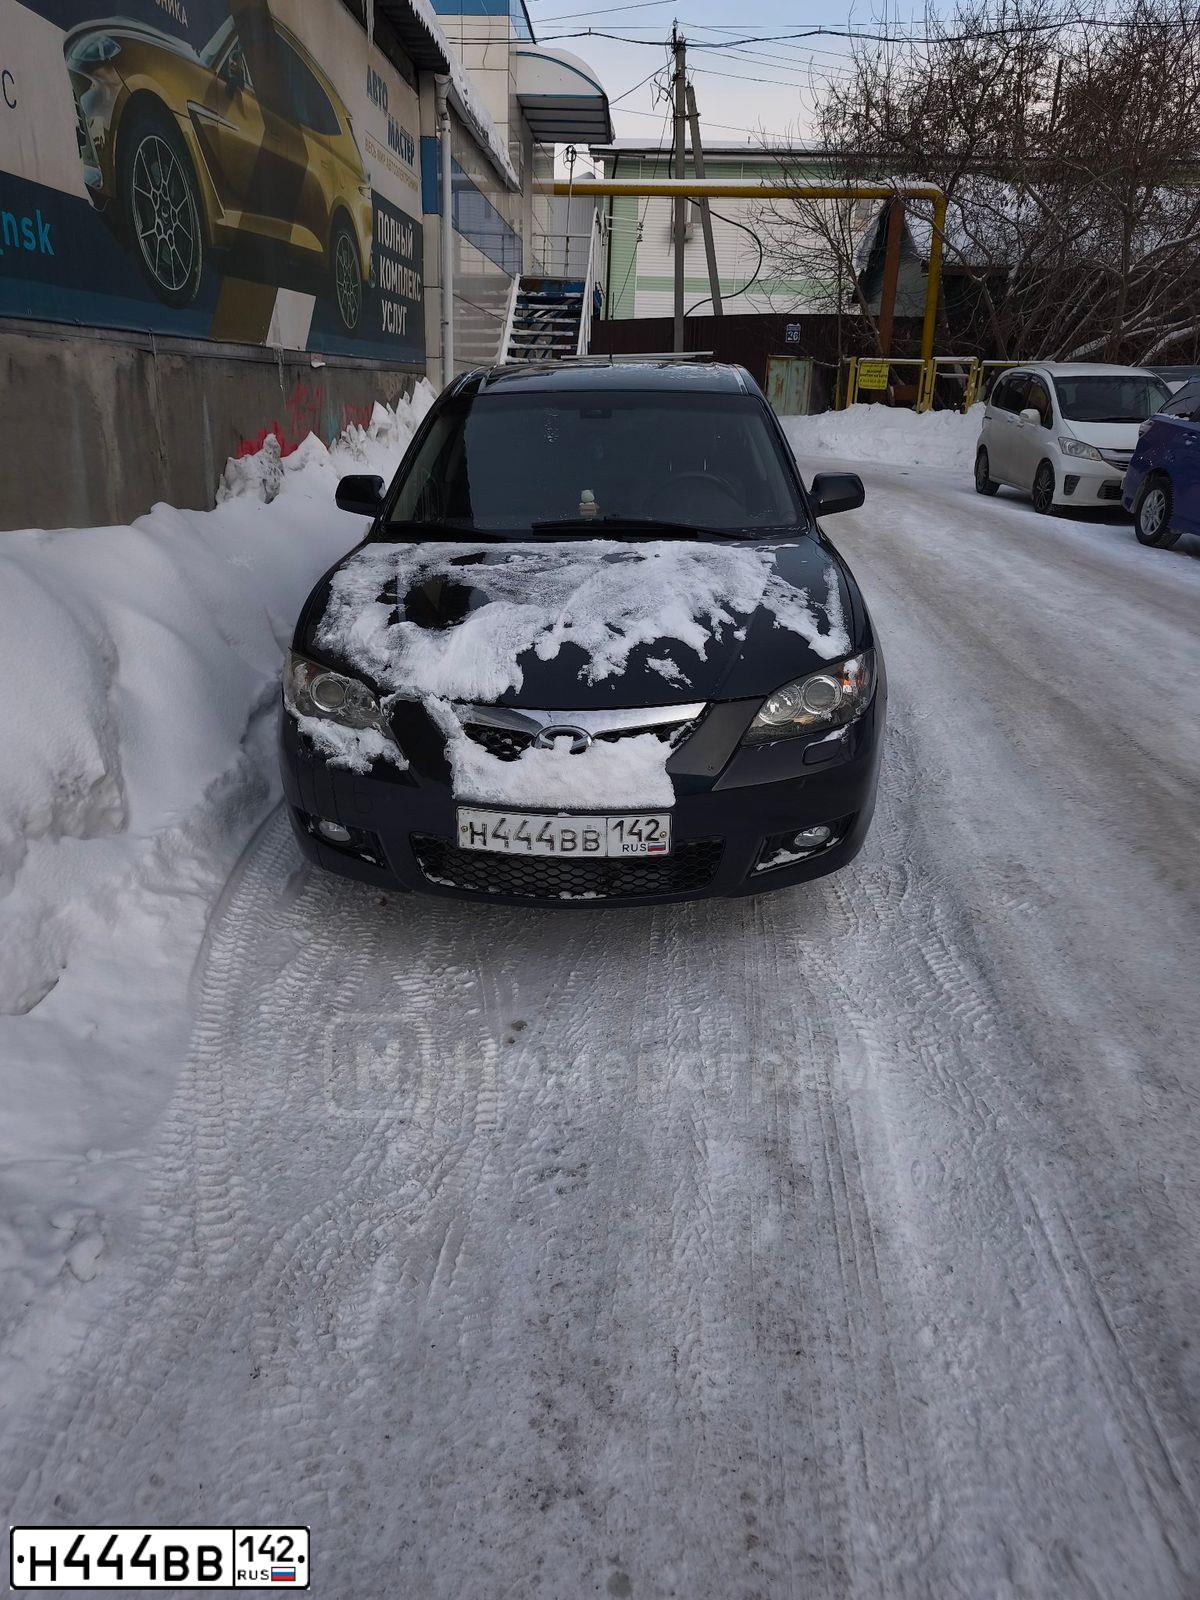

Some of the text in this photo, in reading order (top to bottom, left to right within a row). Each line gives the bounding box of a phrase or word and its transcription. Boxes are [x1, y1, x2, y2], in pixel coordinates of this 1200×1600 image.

[154, 0, 189, 29] НИКА
[366, 64, 388, 114] АВТО
[387, 116, 415, 168] МАСТЕР
[0, 209, 55, 256] nsk
[377, 209, 413, 260] ПОЛНЫЙ
[379, 254, 421, 302] КОМПЛЕКС
[381, 299, 408, 336] УСЛУГ
[468, 817, 661, 852] Н444ВВ 142
[622, 843, 647, 853] RUS
